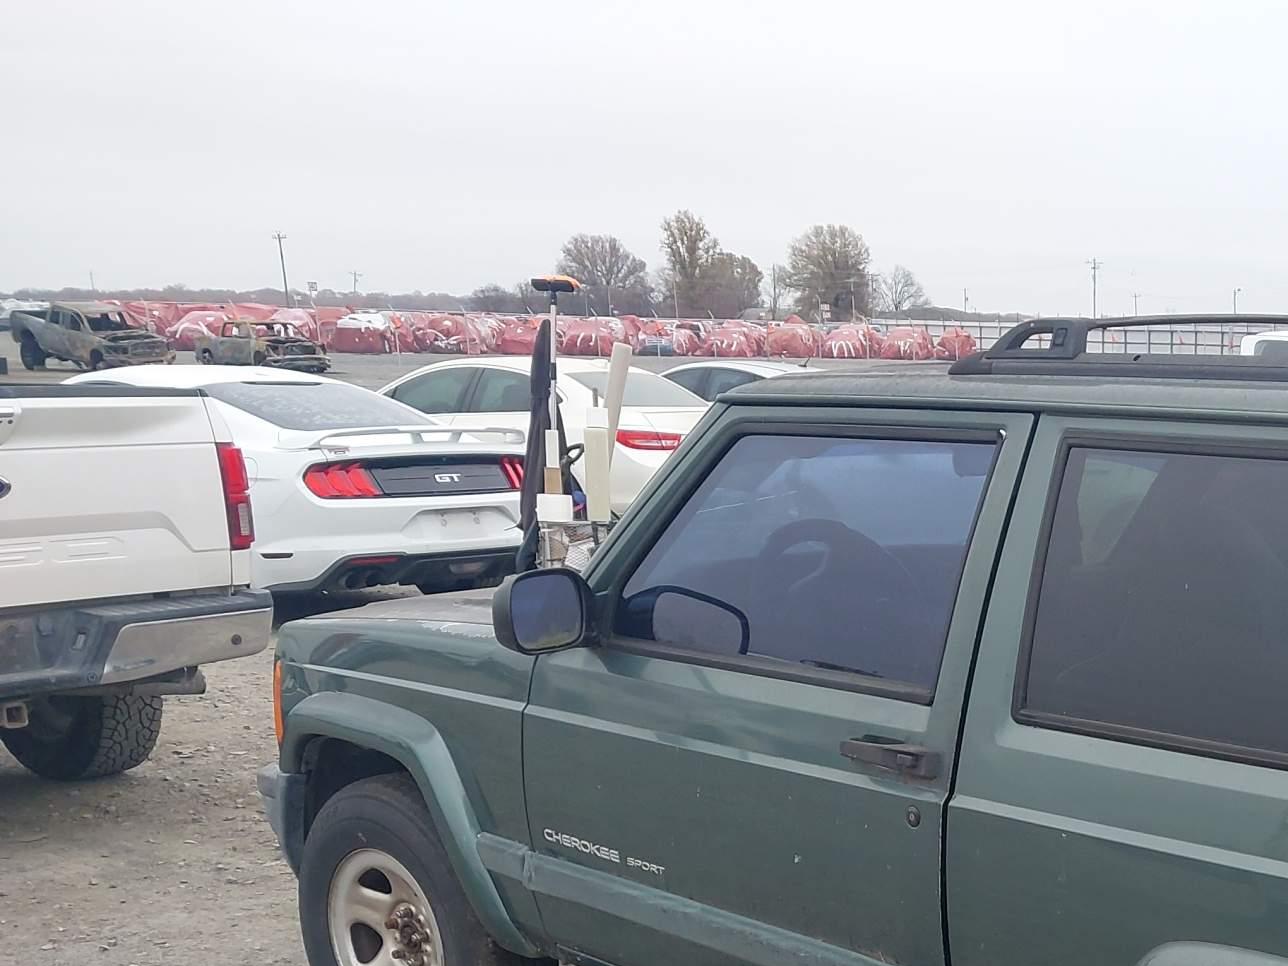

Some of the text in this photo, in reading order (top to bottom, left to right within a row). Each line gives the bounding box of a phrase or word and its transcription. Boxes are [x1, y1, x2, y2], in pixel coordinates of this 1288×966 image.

[434, 473, 462, 483] GT
[543, 828, 665, 875] CHEROKEE SPORT
